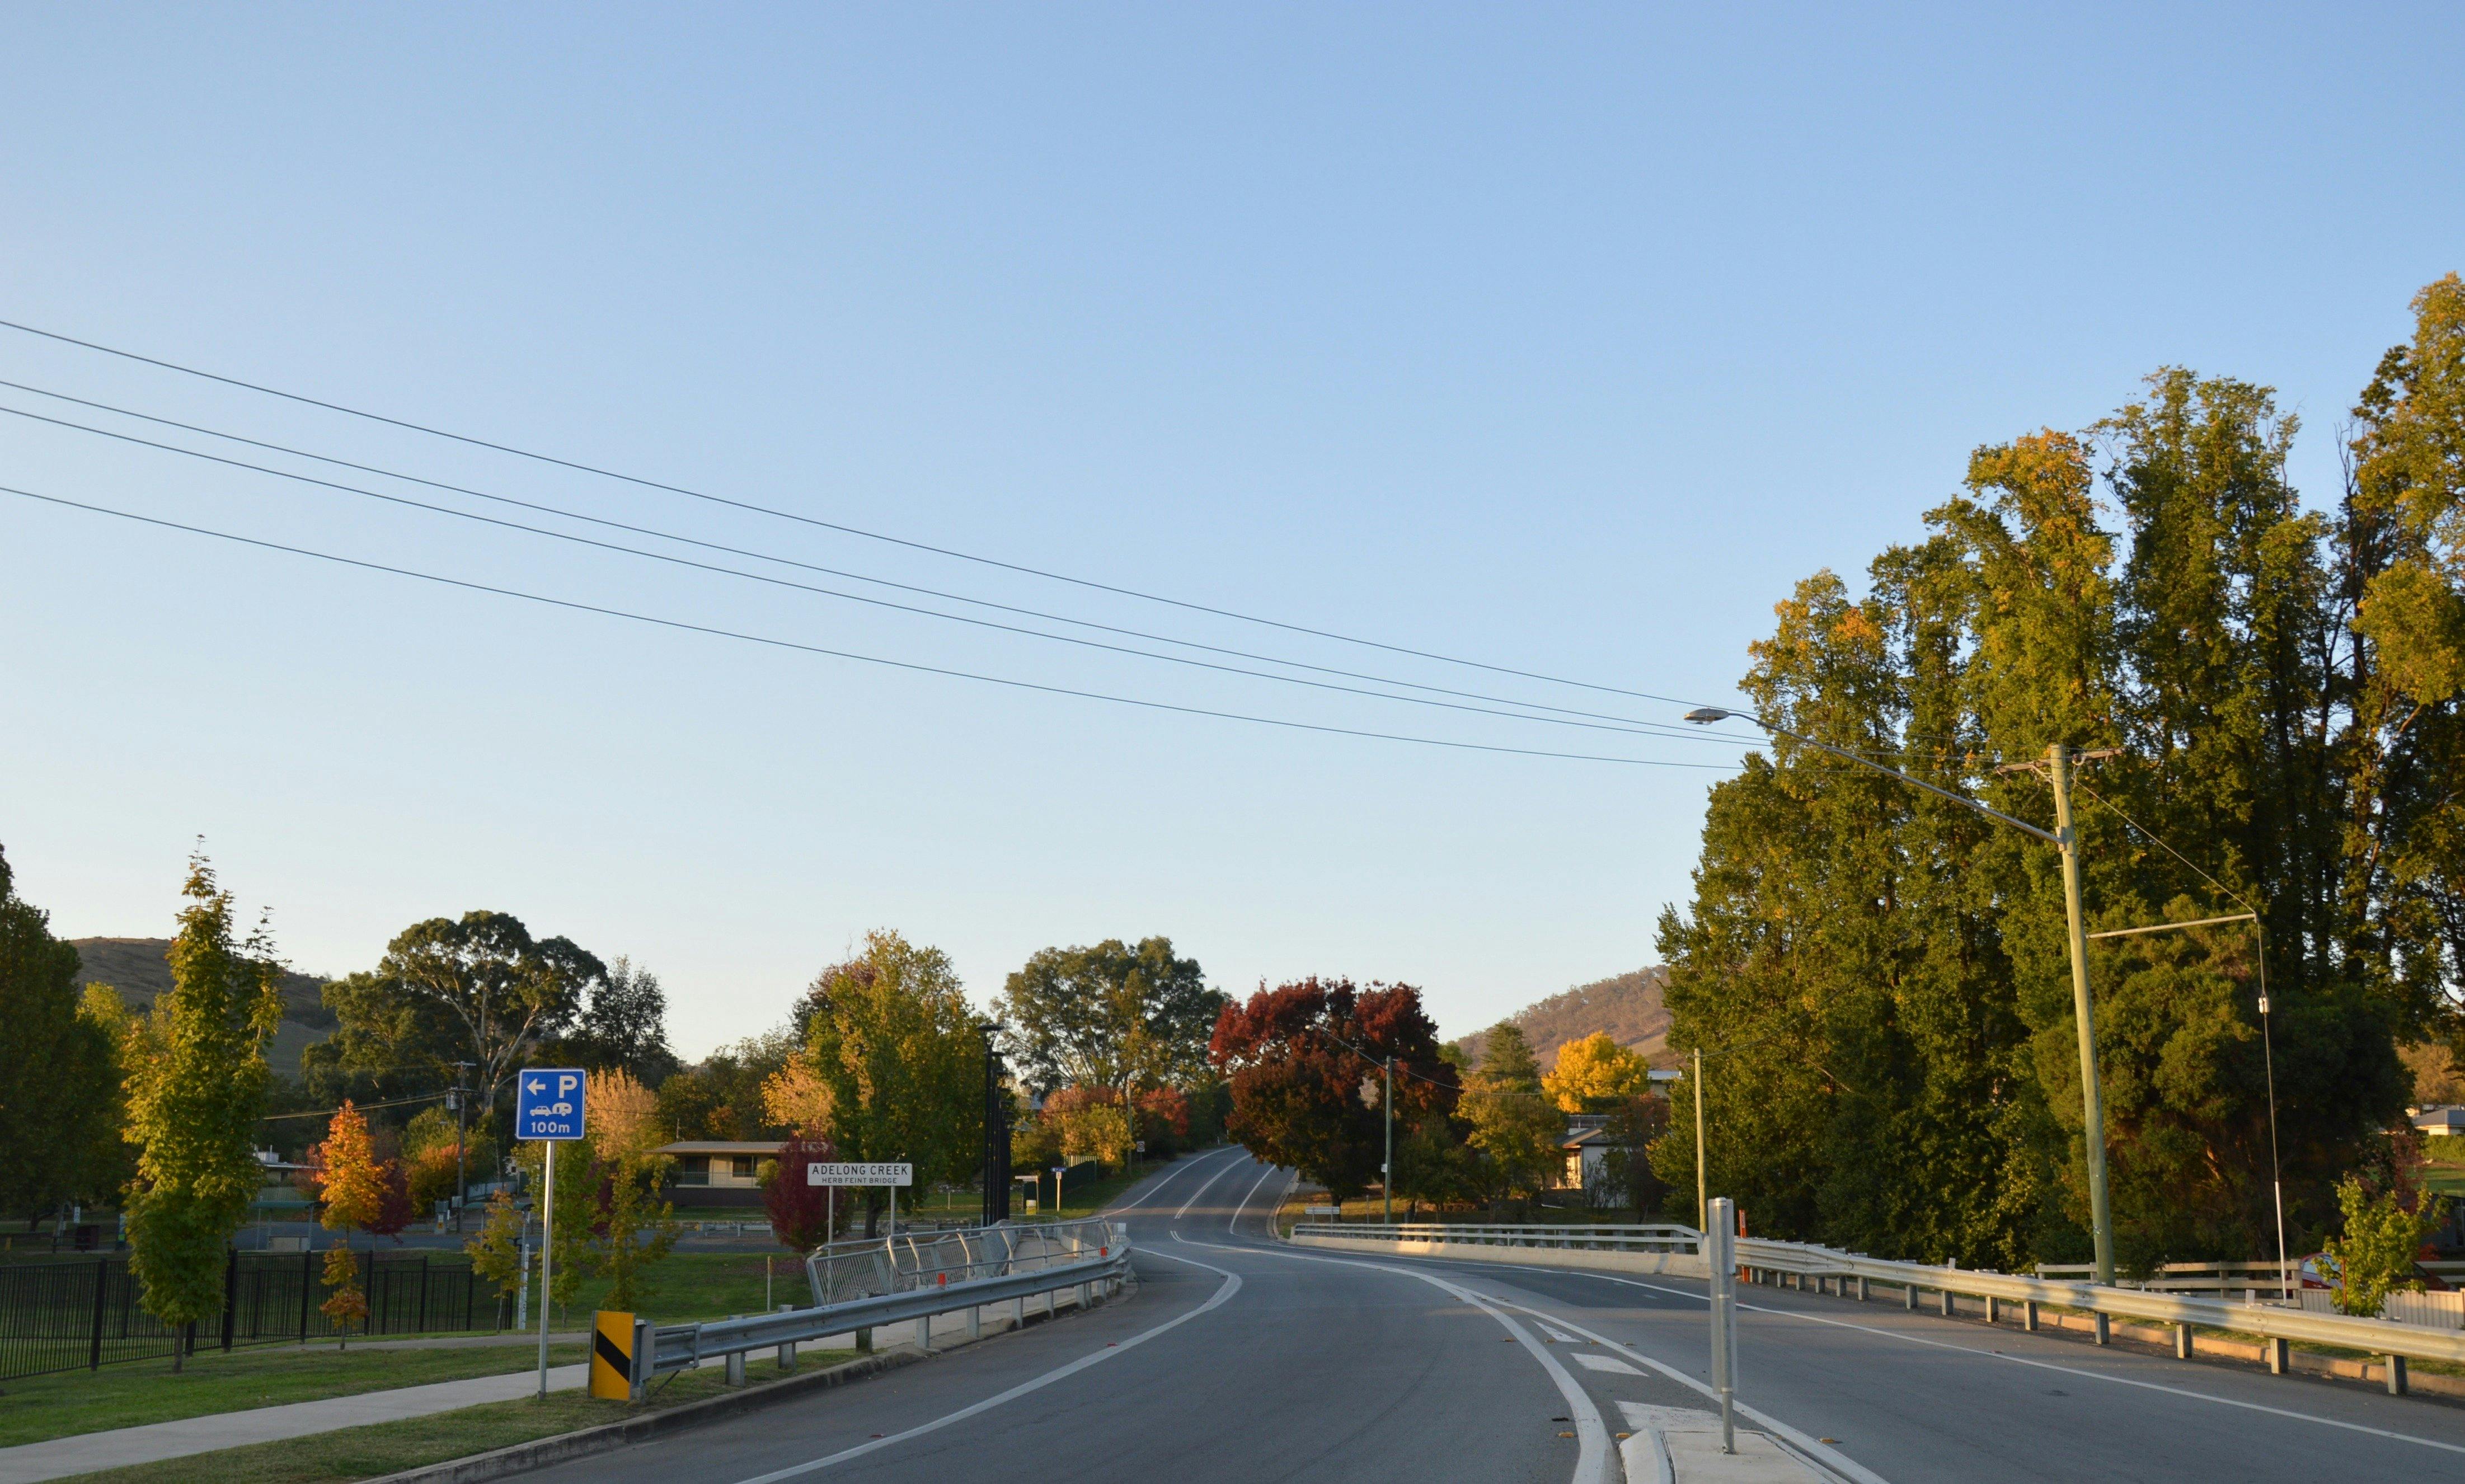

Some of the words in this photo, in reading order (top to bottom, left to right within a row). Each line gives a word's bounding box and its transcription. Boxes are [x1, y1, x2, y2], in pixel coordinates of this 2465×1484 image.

[558, 1075, 577, 1098] P
[531, 1121, 570, 1133] 100m
[812, 1165, 866, 1175] ADELONG
[870, 1165, 908, 1175] CREEK
